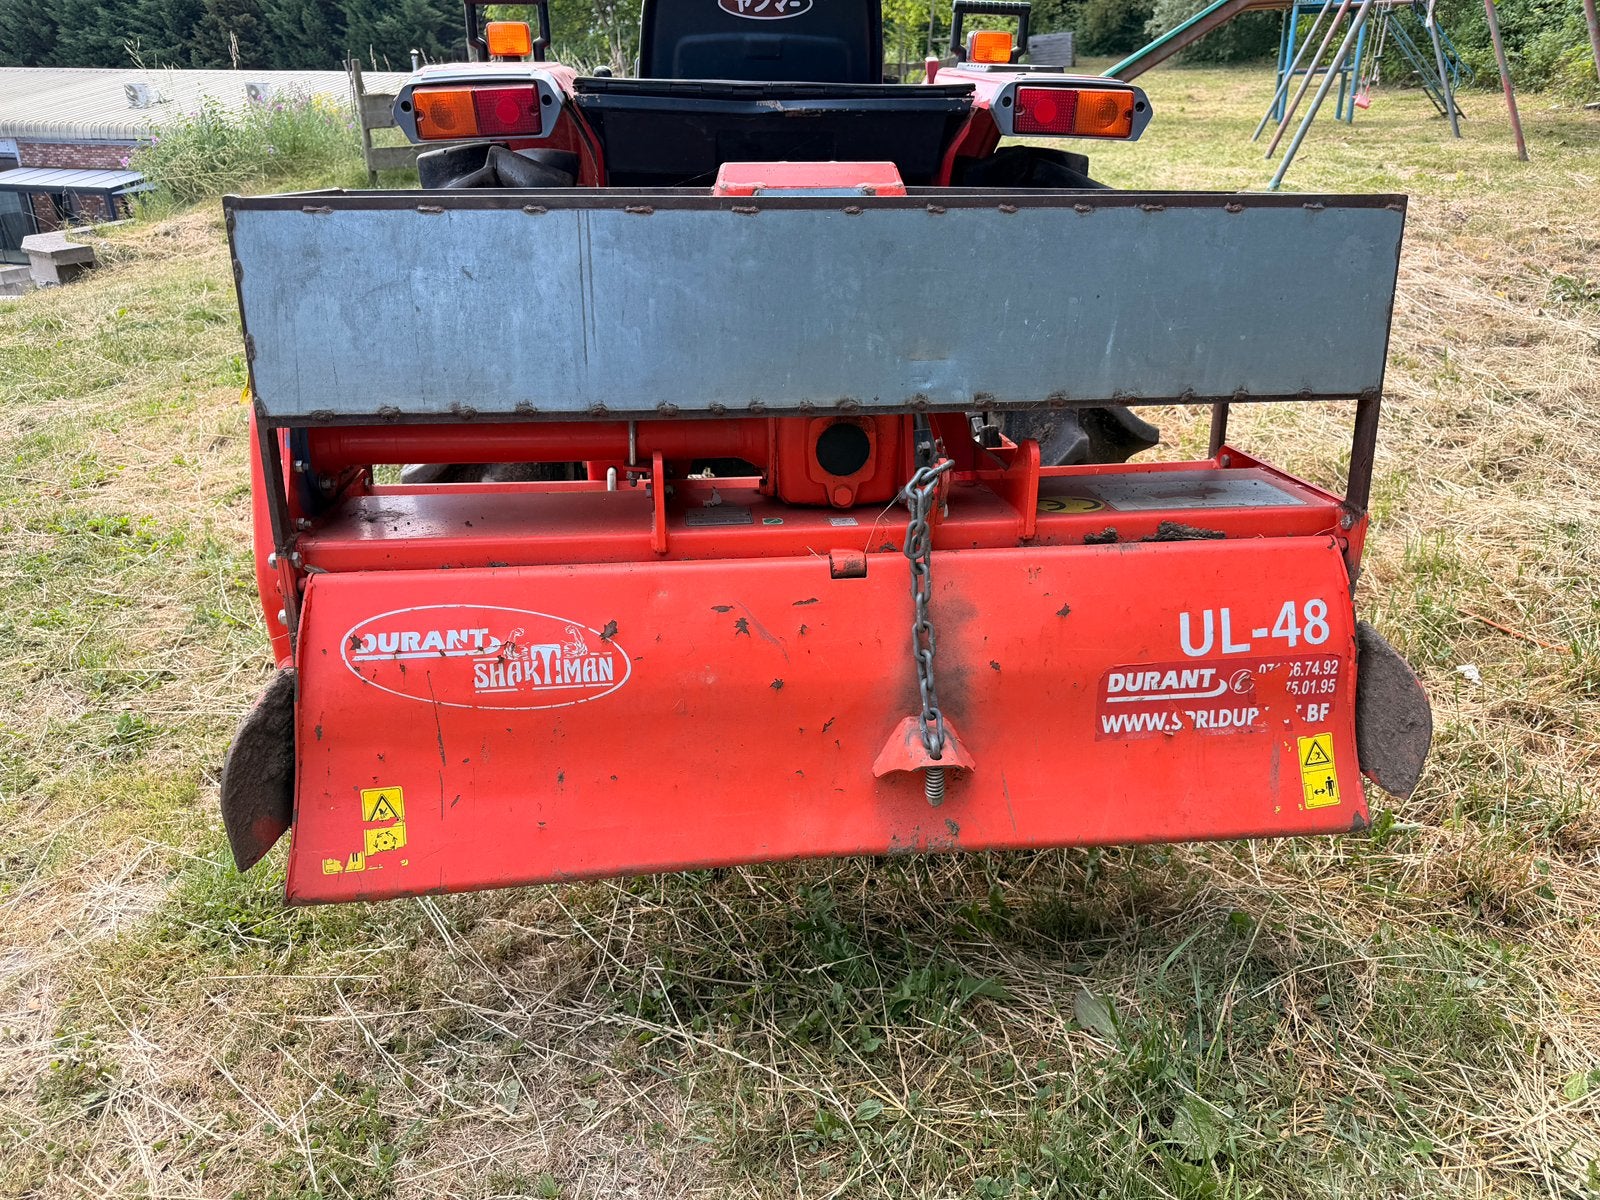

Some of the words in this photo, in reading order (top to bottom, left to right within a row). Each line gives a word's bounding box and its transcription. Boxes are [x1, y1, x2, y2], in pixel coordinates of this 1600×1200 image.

[354, 628, 490, 654] DURANT
[1179, 598, 1331, 657] UL-48
[473, 643, 615, 689] SHAKTIMAN
[1106, 668, 1217, 693] DURANT
